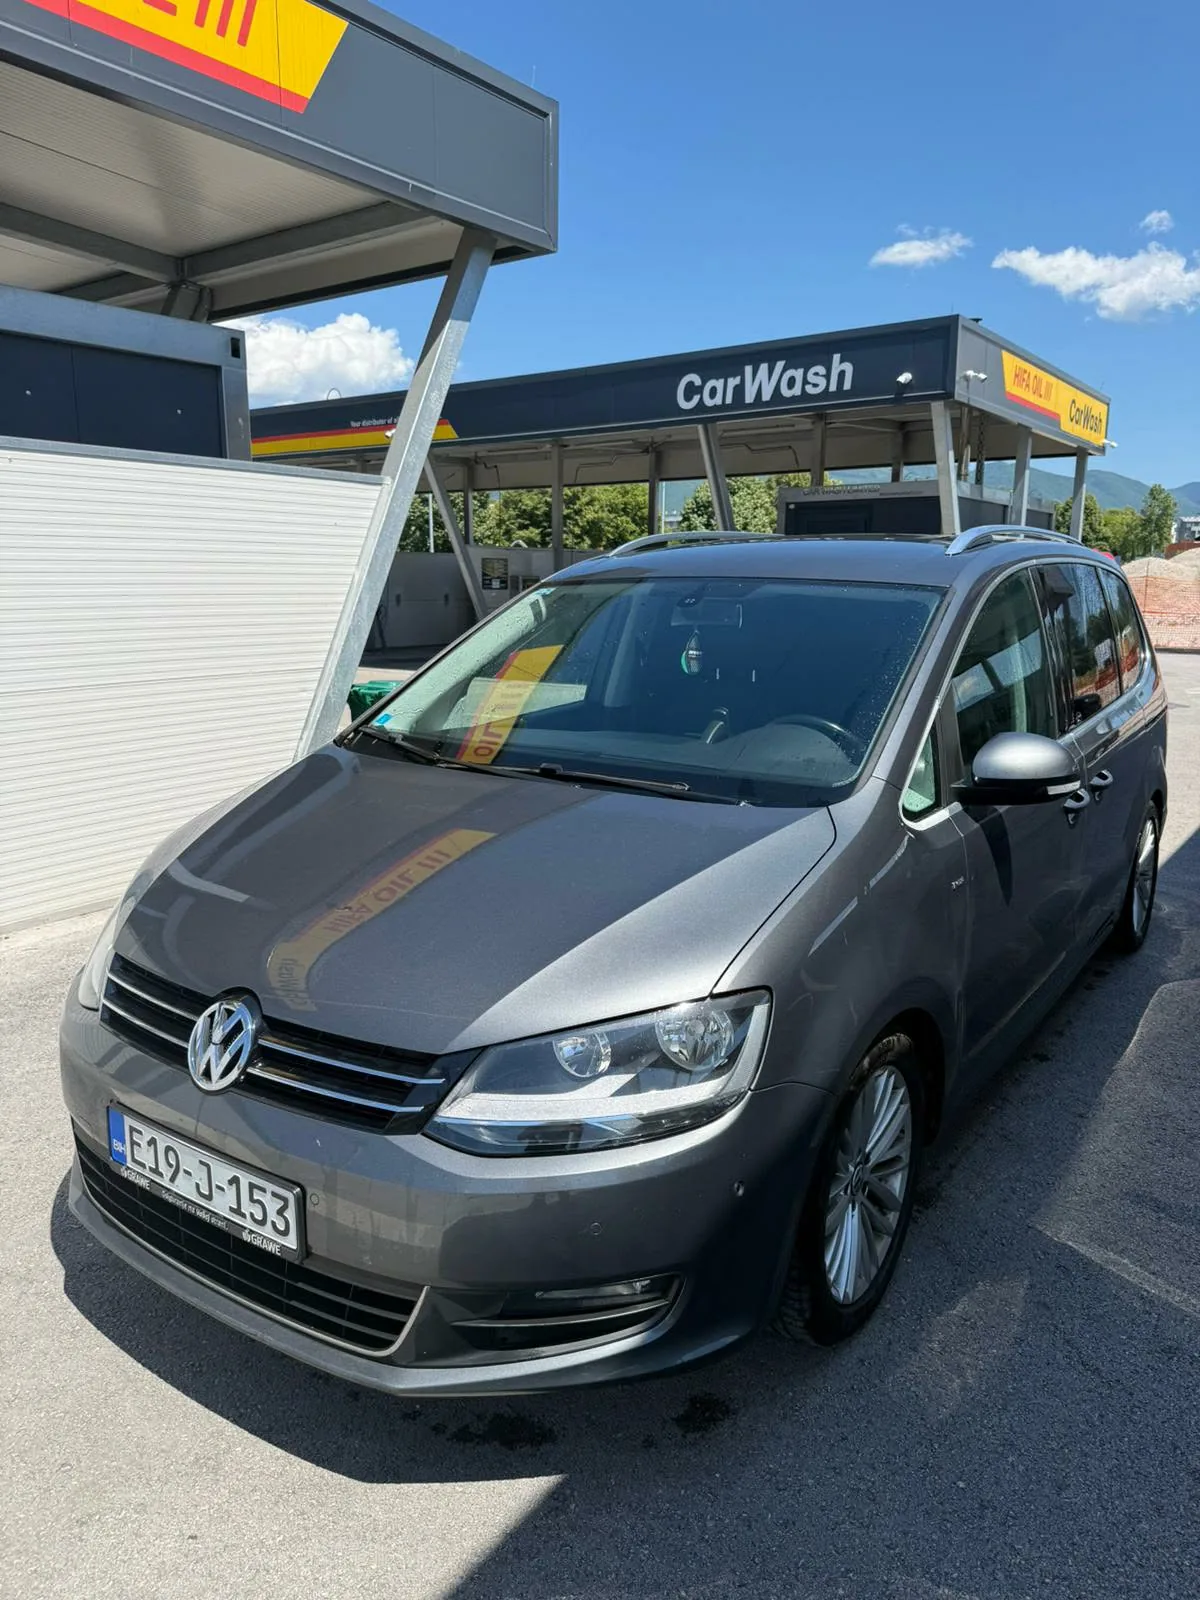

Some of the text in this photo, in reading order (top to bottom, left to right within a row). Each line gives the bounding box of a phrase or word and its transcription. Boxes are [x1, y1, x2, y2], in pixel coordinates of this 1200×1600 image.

[677, 353, 853, 410] CarWash
[1013, 364, 1031, 393] HIFA
[1032, 375, 1043, 399] OIL
[1069, 399, 1103, 434] CarWash
[128, 1124, 291, 1238] E19-J-153
[251, 1233, 281, 1256] GRAWE
